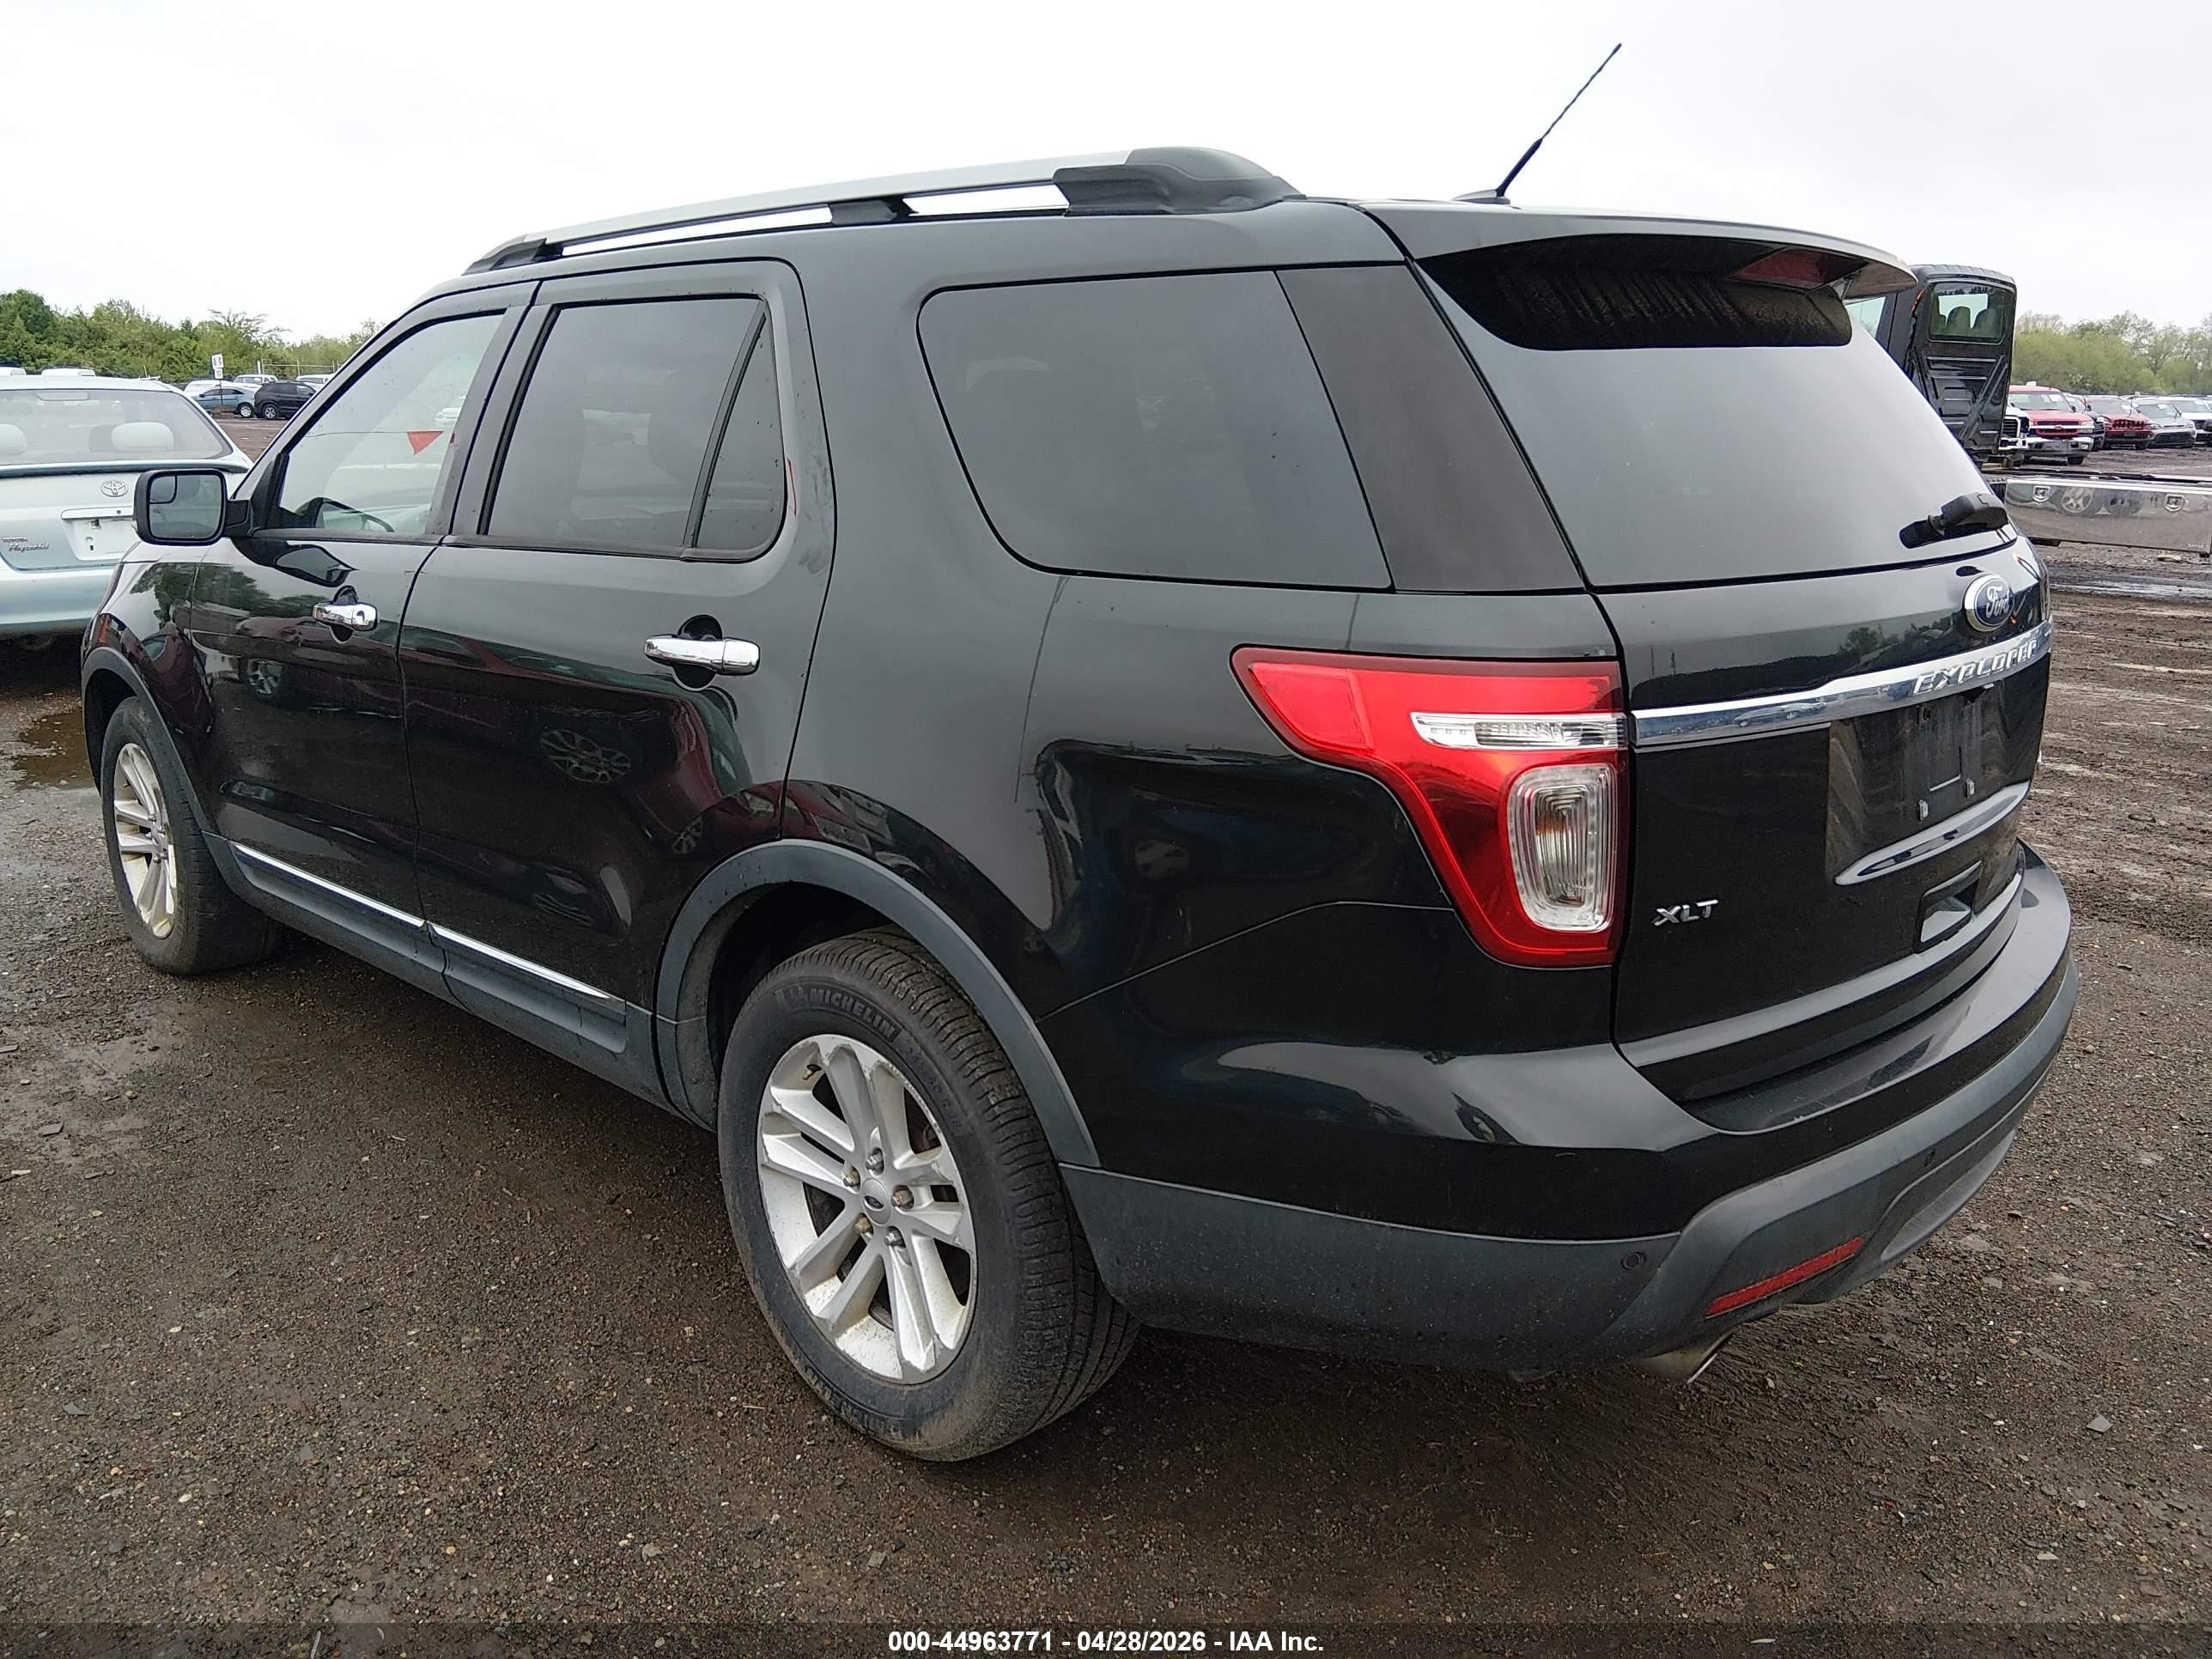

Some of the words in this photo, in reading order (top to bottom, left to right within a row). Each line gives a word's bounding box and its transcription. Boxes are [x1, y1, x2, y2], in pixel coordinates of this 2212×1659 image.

[1986, 586, 2009, 618] Ford
[1913, 640, 2037, 694] EXPLORER
[1650, 898, 1719, 927] XLT
[810, 988, 896, 1039] MICHELIN
